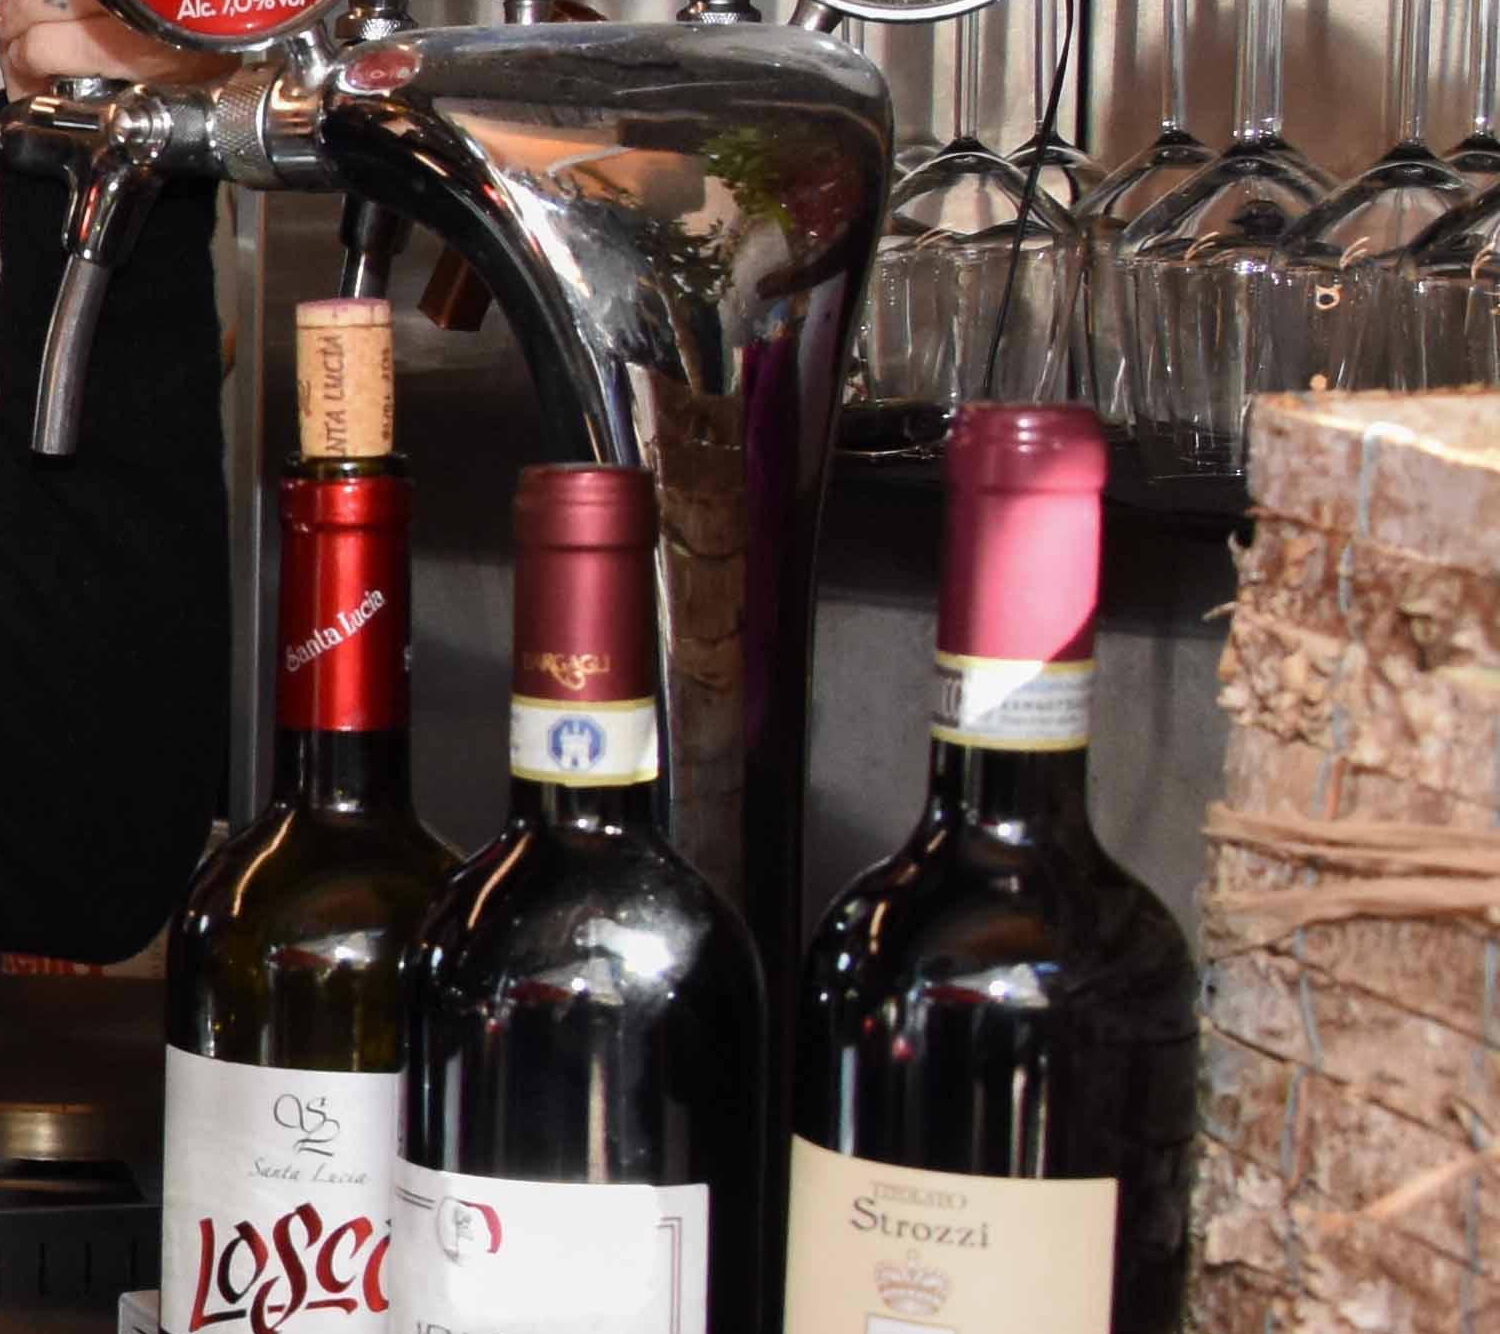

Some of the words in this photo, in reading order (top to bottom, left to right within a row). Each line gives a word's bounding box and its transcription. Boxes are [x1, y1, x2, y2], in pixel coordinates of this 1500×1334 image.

[325, 410, 347, 456] NTA
[286, 627, 345, 673] Santa
[336, 589, 387, 638] Lucia
[249, 1156, 301, 1184] Santa
[311, 1161, 369, 1185] Lucia
[848, 1195, 991, 1251] Strozzi
